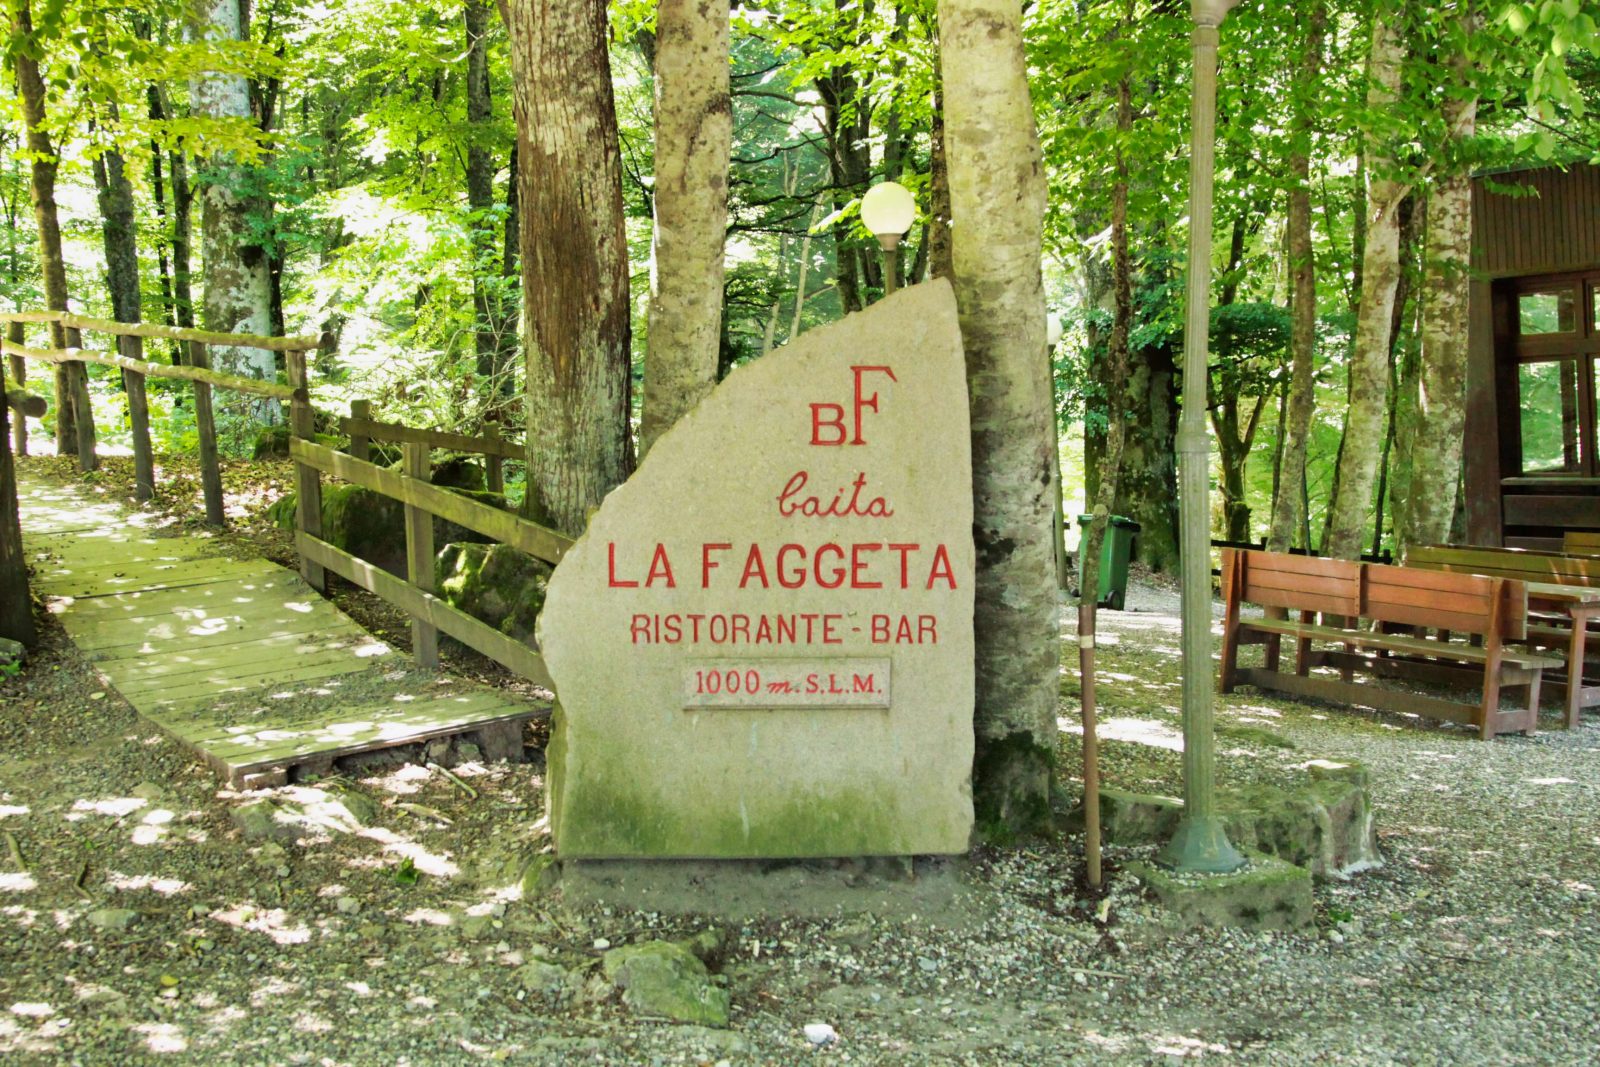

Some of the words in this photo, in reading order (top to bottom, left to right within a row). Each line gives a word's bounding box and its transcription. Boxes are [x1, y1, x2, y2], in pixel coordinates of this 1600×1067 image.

[809, 365, 898, 446] BF
[776, 470, 894, 518] baita
[607, 542, 677, 589] LA
[701, 542, 958, 591] FAGGETA
[630, 613, 844, 645] RISTORANTE
[871, 614, 938, 645] BAR
[695, 669, 761, 696] 1000
